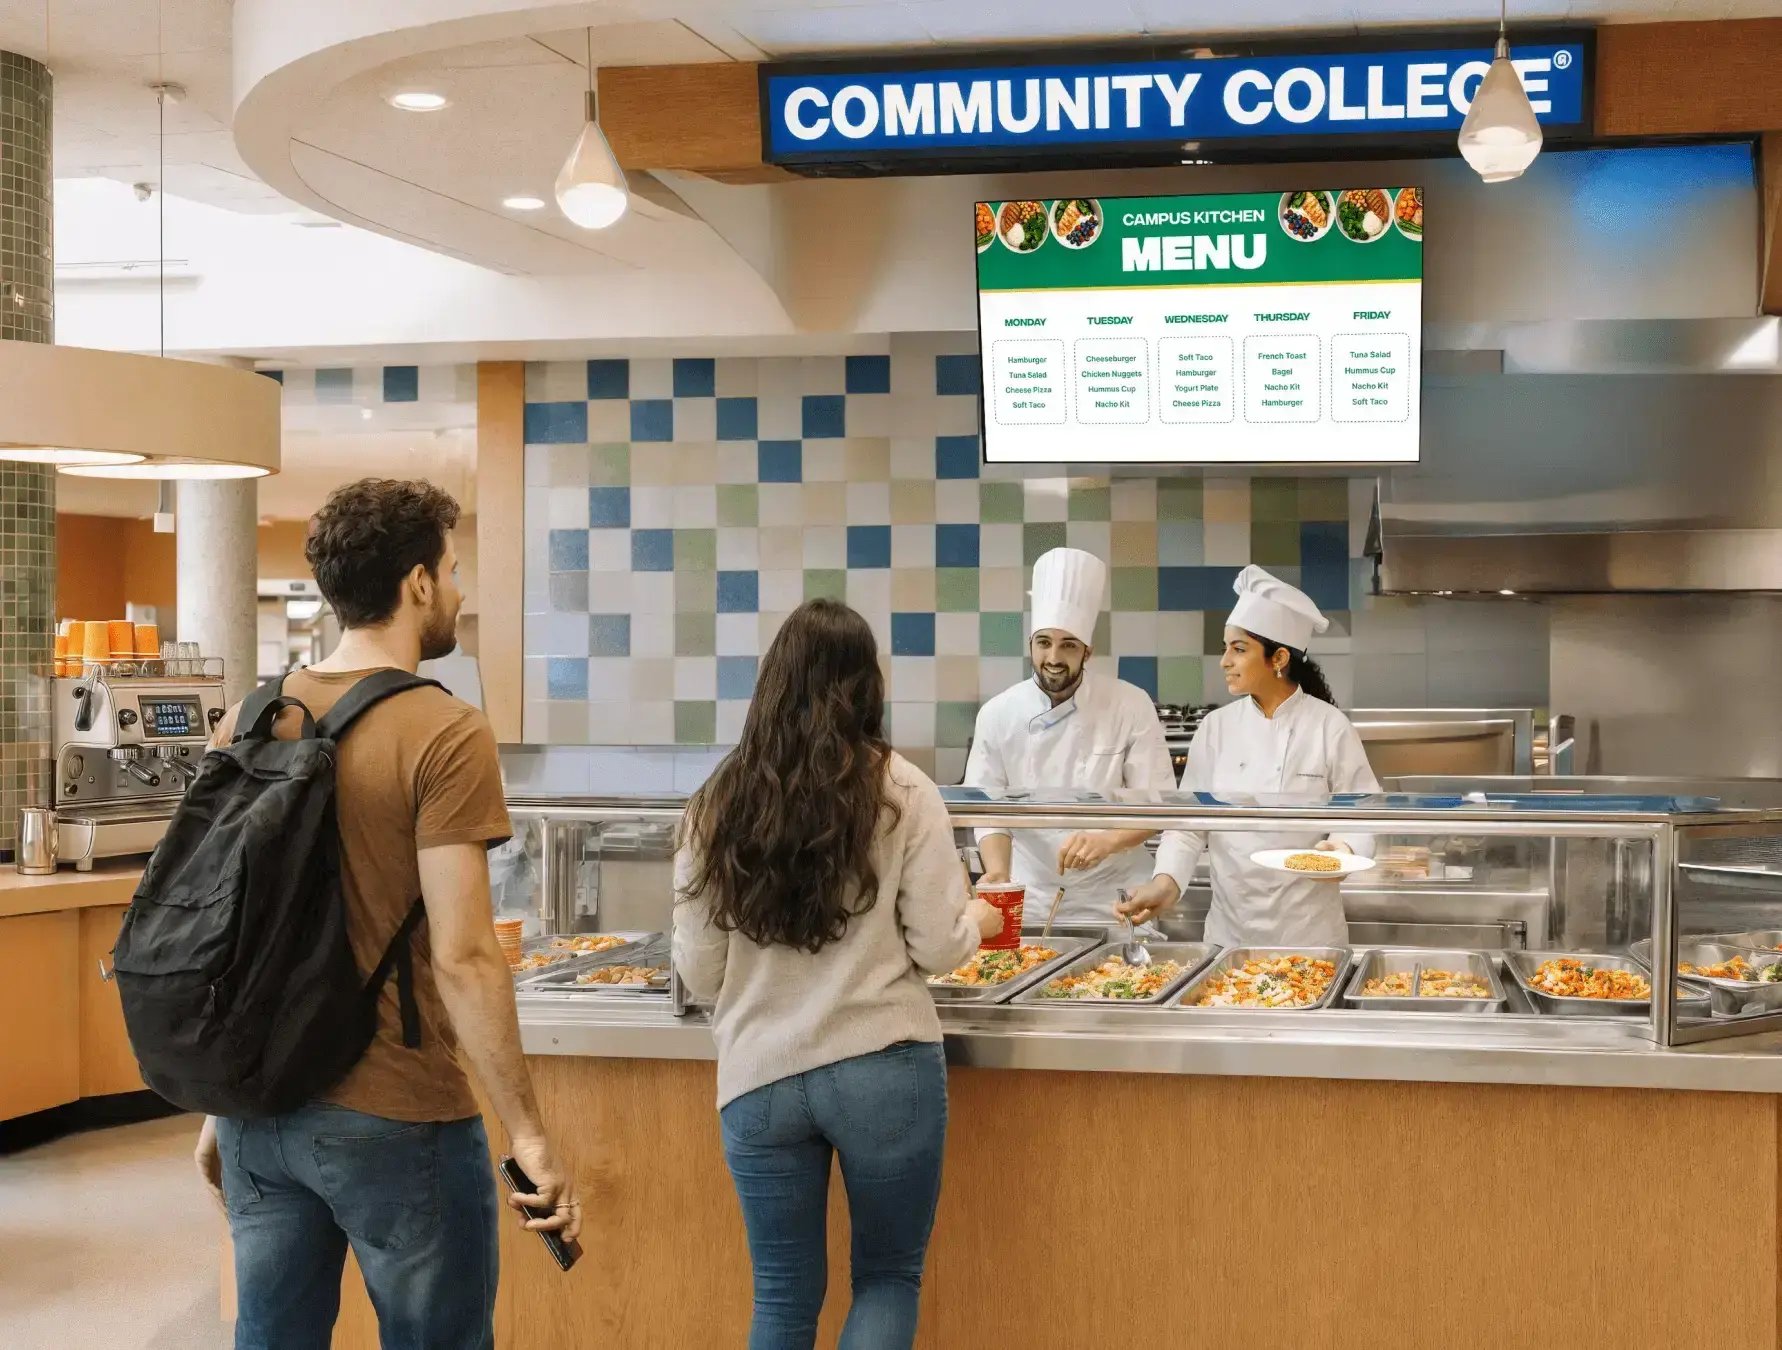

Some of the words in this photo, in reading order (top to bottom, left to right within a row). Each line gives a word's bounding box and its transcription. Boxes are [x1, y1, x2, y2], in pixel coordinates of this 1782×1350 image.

[784, 73, 1203, 141] COMMUNITY
[1122, 211, 1191, 226] CAMPUS
[1194, 209, 1265, 224] KITCHEN
[1121, 233, 1267, 272] MENU
[1164, 314, 1229, 324] WEDNESDAY
[1253, 312, 1311, 322] THURSDAY
[1353, 311, 1391, 320] FRIDAY
[1004, 318, 1047, 327] MONDAY
[1086, 316, 1134, 325] TUESDAY
[1085, 355, 1137, 363] Cheeseburger
[1178, 353, 1194, 361] Soft
[1195, 353, 1214, 361] Taco
[1257, 352, 1284, 360] French
[1285, 351, 1307, 359] Toast
[1349, 351, 1369, 359] Tuna
[1370, 350, 1392, 358] Salad
[1007, 356, 1048, 365] Hamburger
[1008, 371, 1027, 379] Tuna
[1027, 371, 1048, 379] Salad
[1081, 370, 1111, 378] Chicken
[1111, 370, 1142, 379] Nuggets
[1175, 369, 1217, 378] Hamburger
[1271, 367, 1293, 377] Bagel
[1344, 367, 1379, 375] Hummus
[1379, 366, 1396, 376] Cup
[1005, 386, 1032, 394] Cheese
[1032, 386, 1052, 394] Pizza
[1087, 385, 1120, 393] Hummus
[1121, 385, 1137, 394] Cup
[1174, 384, 1199, 393] Yogurt
[1200, 384, 1219, 392] Plate
[1264, 382, 1289, 391] Nacho
[1289, 382, 1301, 390] Kit
[1351, 382, 1377, 390] Nacho
[1377, 382, 1389, 390] Kit
[1012, 401, 1028, 409] Soft
[1028, 401, 1046, 409] Taco
[1095, 400, 1119, 408] Nacho
[1119, 400, 1130, 408] Kit
[1172, 399, 1200, 407] Cheese
[1201, 399, 1221, 407] Pizza
[1261, 398, 1304, 407] Hamburger
[1352, 398, 1368, 406] Soft
[1370, 397, 1389, 405] Taco
